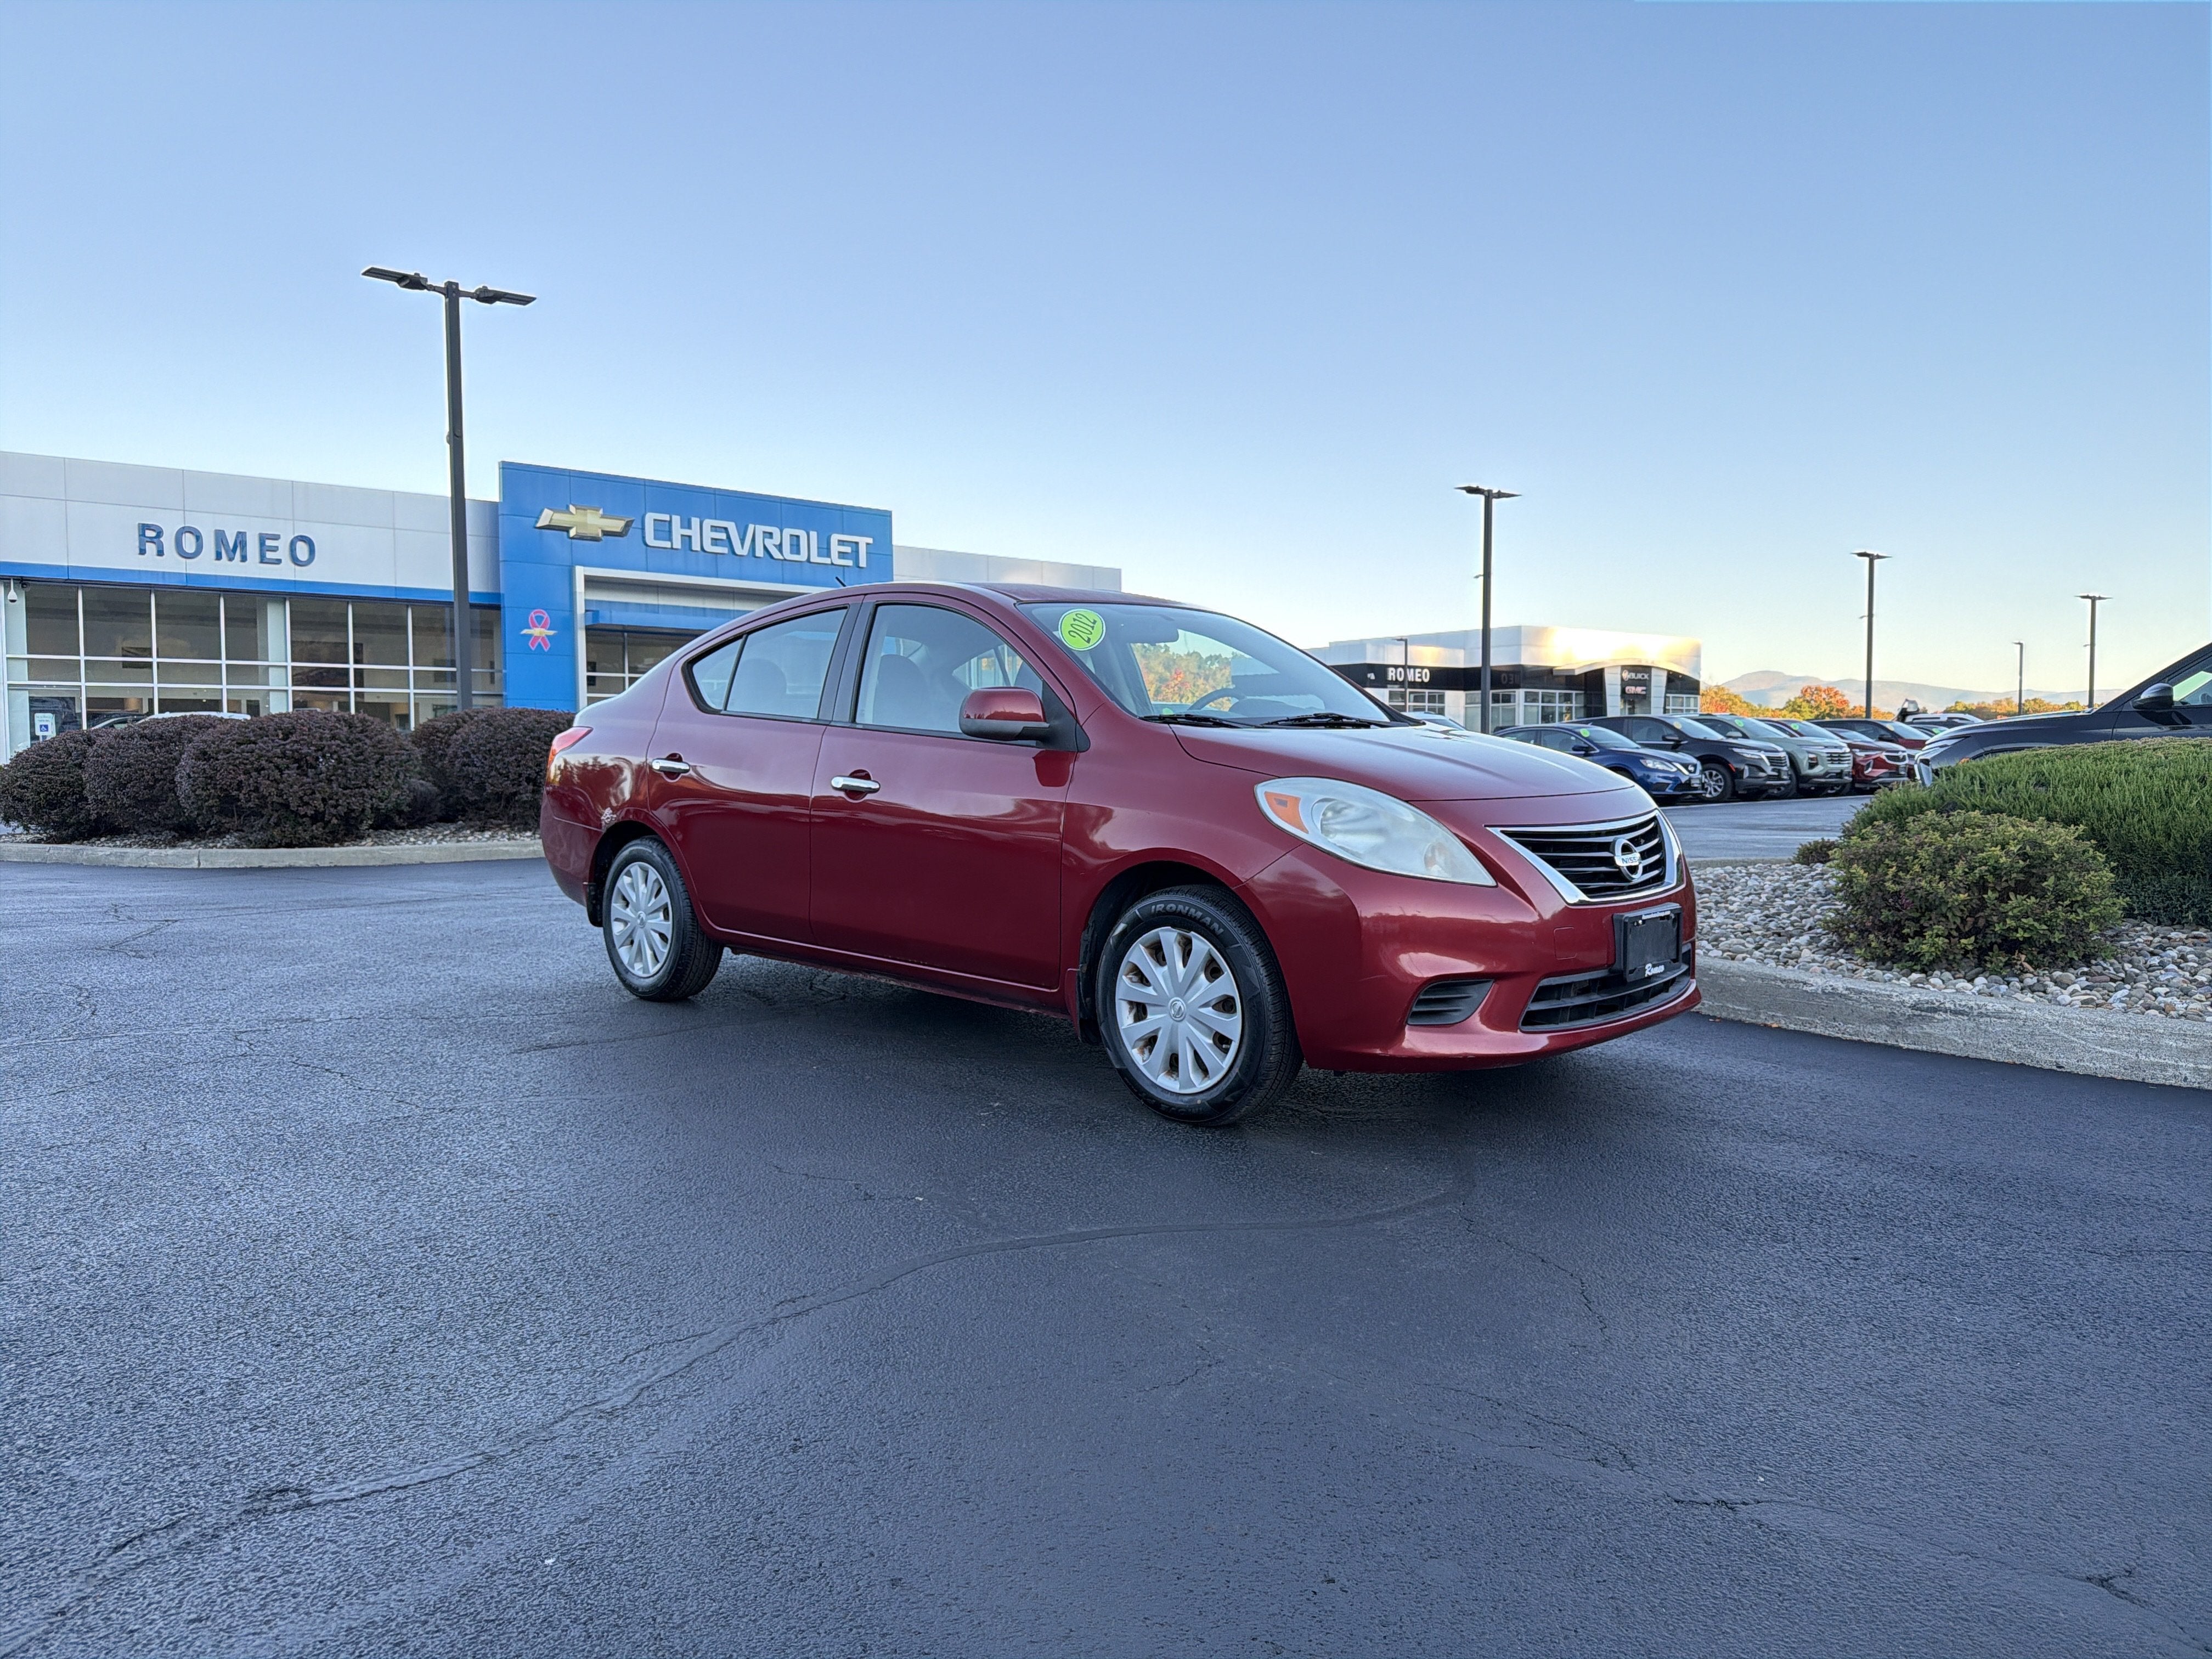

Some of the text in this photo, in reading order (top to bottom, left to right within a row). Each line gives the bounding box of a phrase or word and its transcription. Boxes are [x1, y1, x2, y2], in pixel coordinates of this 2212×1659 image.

[138, 522, 316, 567] ROMEO
[644, 512, 873, 568] CHEVROLET
[1068, 613, 1097, 644] 2012
[1387, 667, 1430, 682] ROMEO
[1625, 686, 1646, 695] GMC
[1151, 904, 1224, 935] IRONMAN
